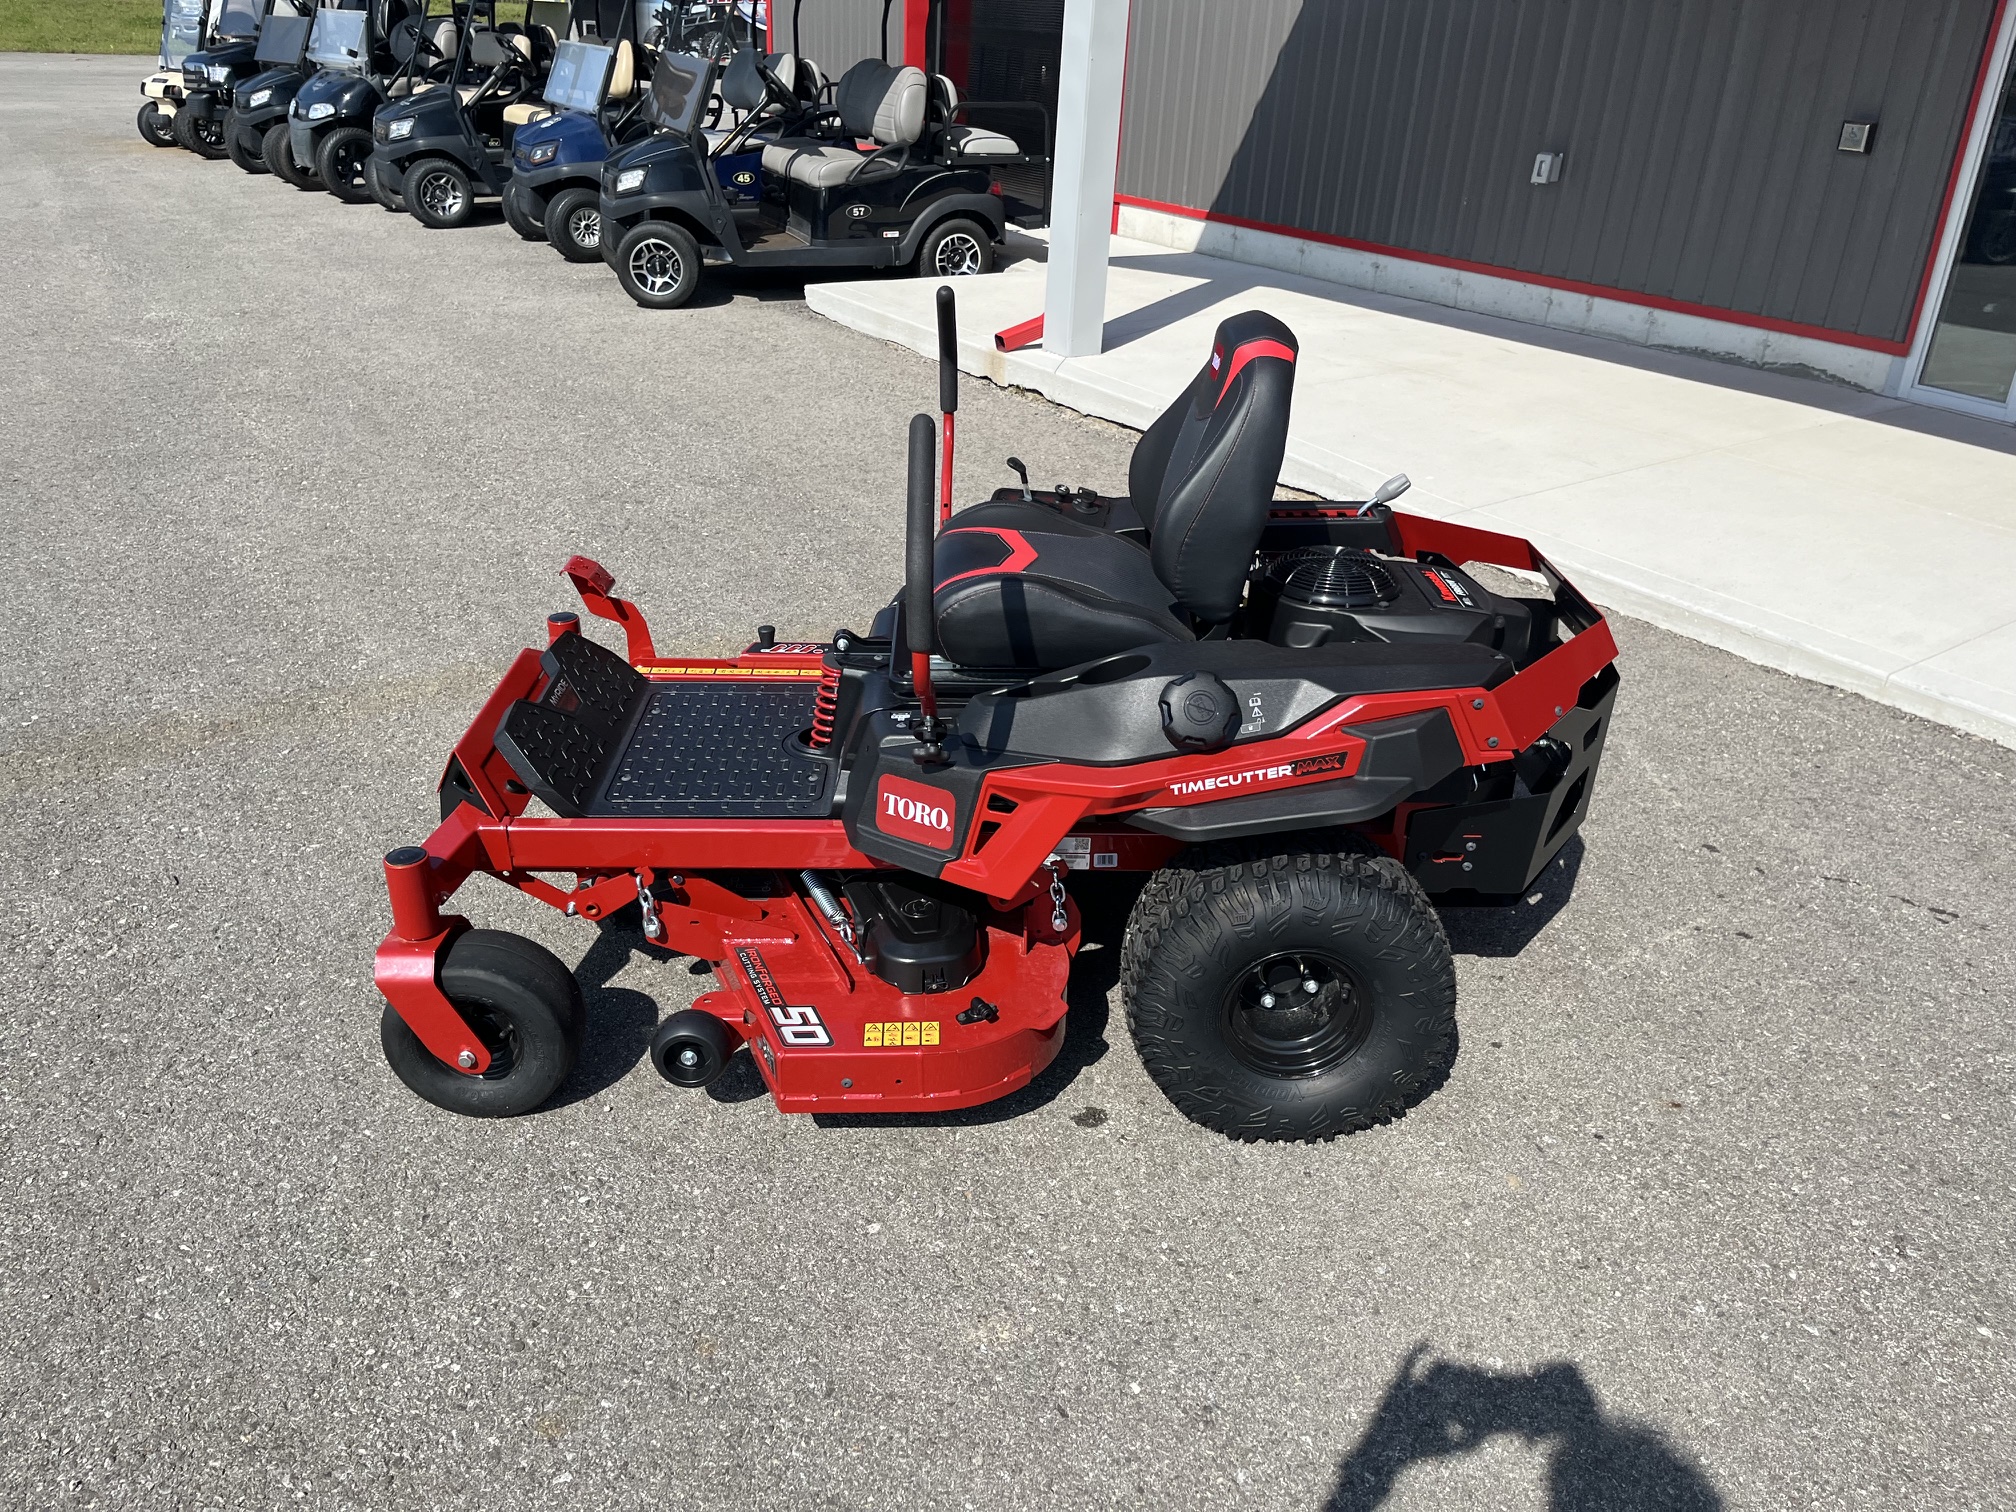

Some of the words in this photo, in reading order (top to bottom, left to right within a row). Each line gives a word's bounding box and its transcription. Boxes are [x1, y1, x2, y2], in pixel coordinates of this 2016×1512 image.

[737, 174, 751, 183] 45
[852, 207, 865, 217] 57
[1170, 764, 1293, 796] TIMECUTTER
[1296, 755, 1342, 776] MAX
[883, 792, 949, 830] TORO
[739, 952, 757, 979] CUTTING
[744, 948, 783, 1006] IRONFORGED
[753, 979, 771, 1005] SYSTEM
[769, 1006, 830, 1044] 50
